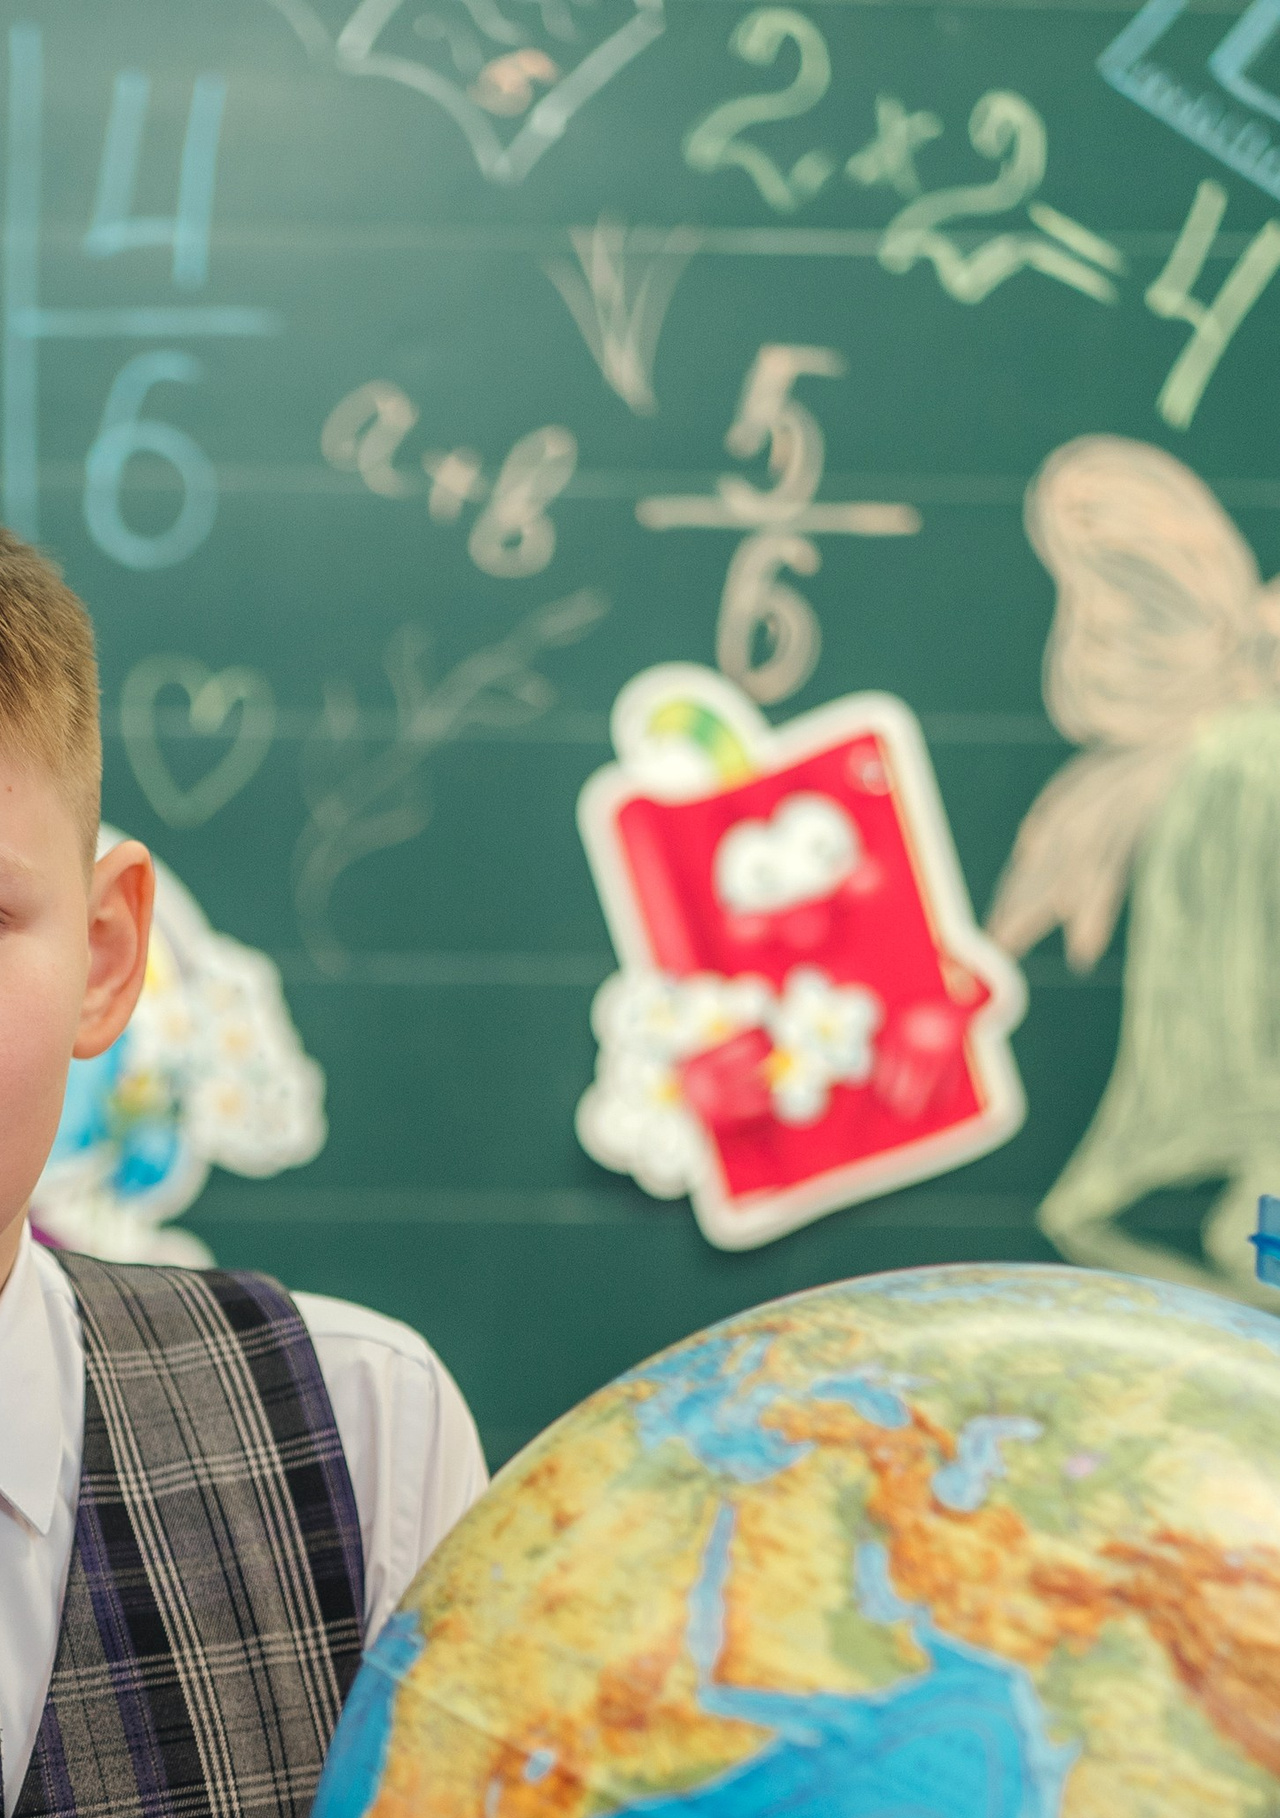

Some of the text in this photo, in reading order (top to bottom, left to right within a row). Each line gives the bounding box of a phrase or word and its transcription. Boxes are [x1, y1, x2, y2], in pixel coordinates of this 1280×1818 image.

[84, 70, 226, 289] 4
[84, 349, 218, 571] 6
[723, 342, 847, 521] 5
[716, 530, 821, 706] 6
